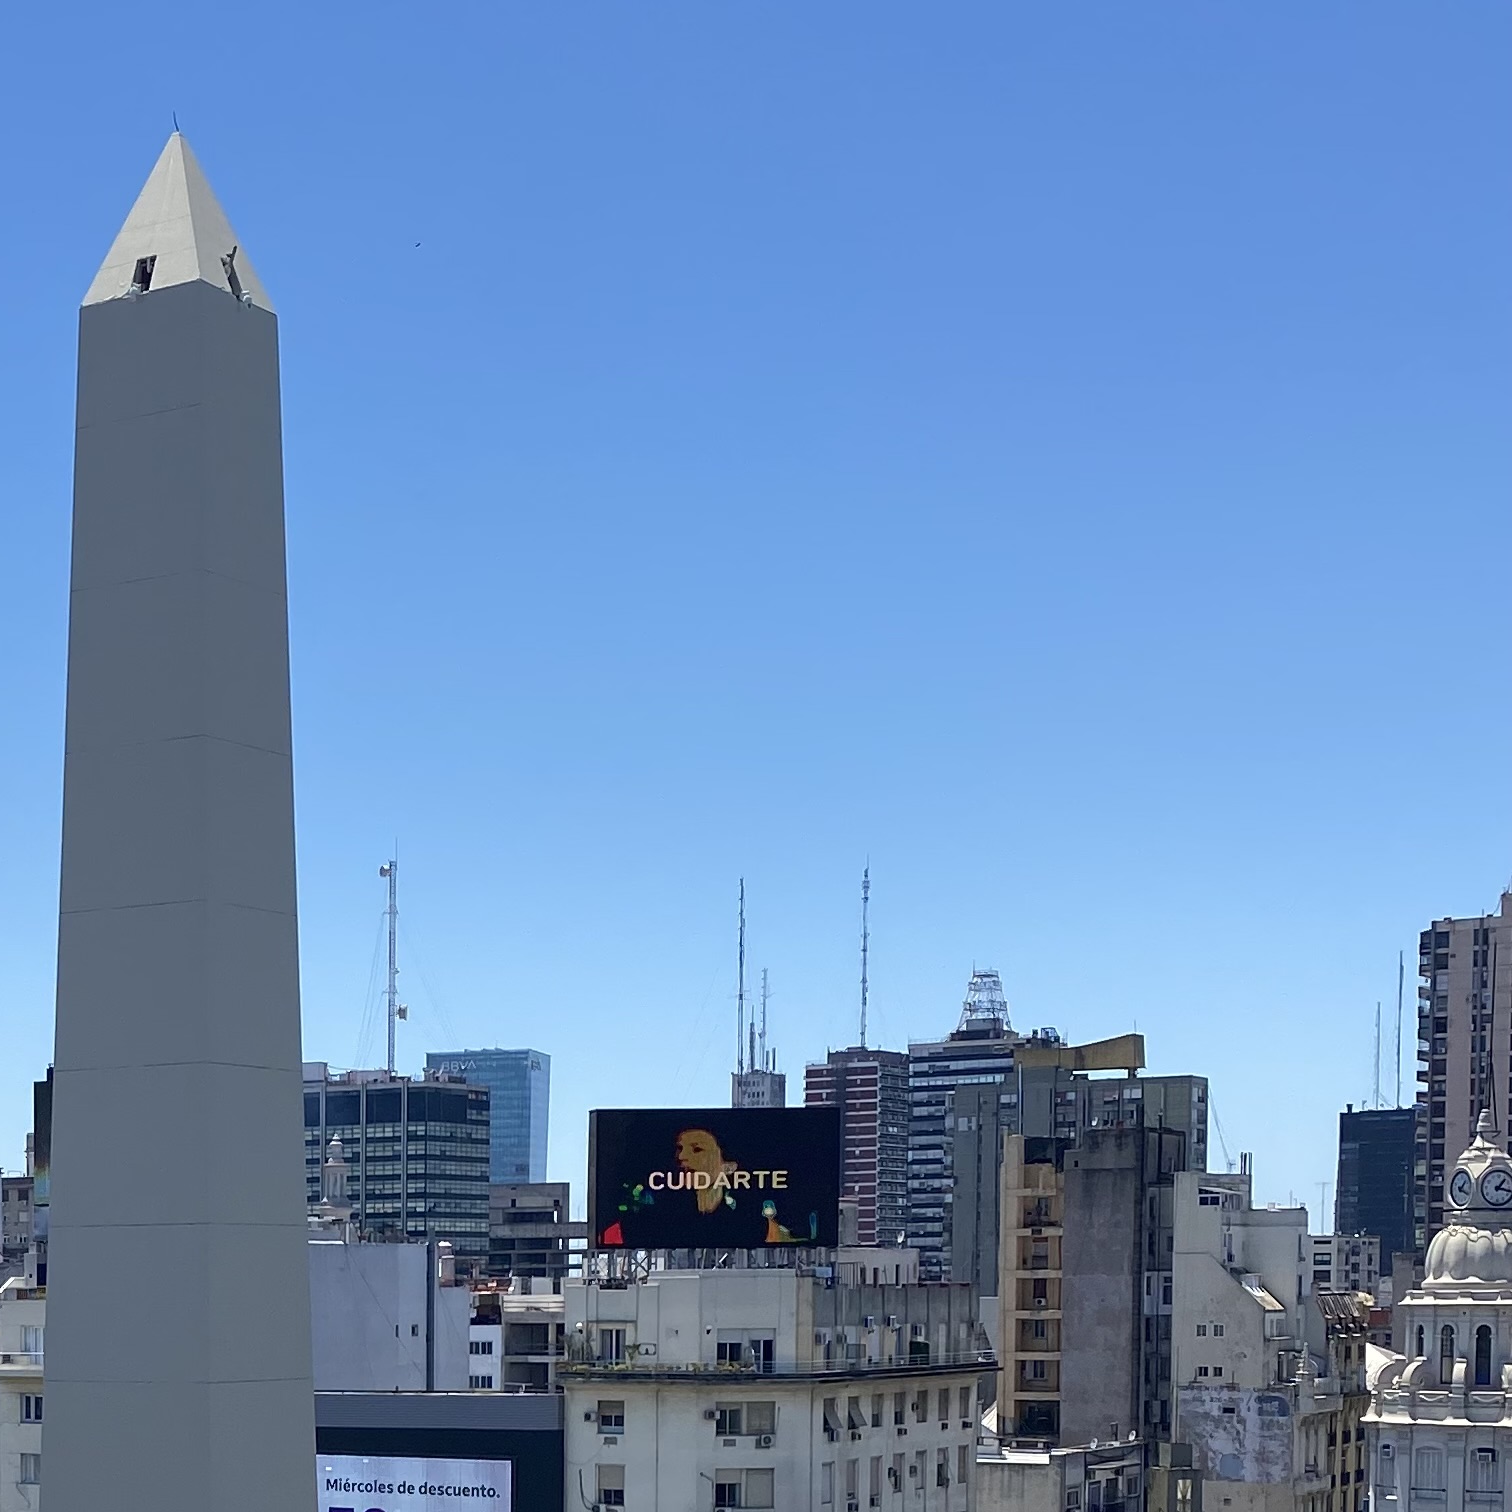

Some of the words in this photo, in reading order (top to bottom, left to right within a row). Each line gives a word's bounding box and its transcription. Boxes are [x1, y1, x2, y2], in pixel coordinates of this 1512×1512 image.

[442, 1060, 476, 1072] BBVA
[648, 1170, 788, 1190] CUIDARTE
[326, 1478, 394, 1494] Miércoles
[397, 1481, 416, 1495] de
[418, 1482, 500, 1498] descuento.
